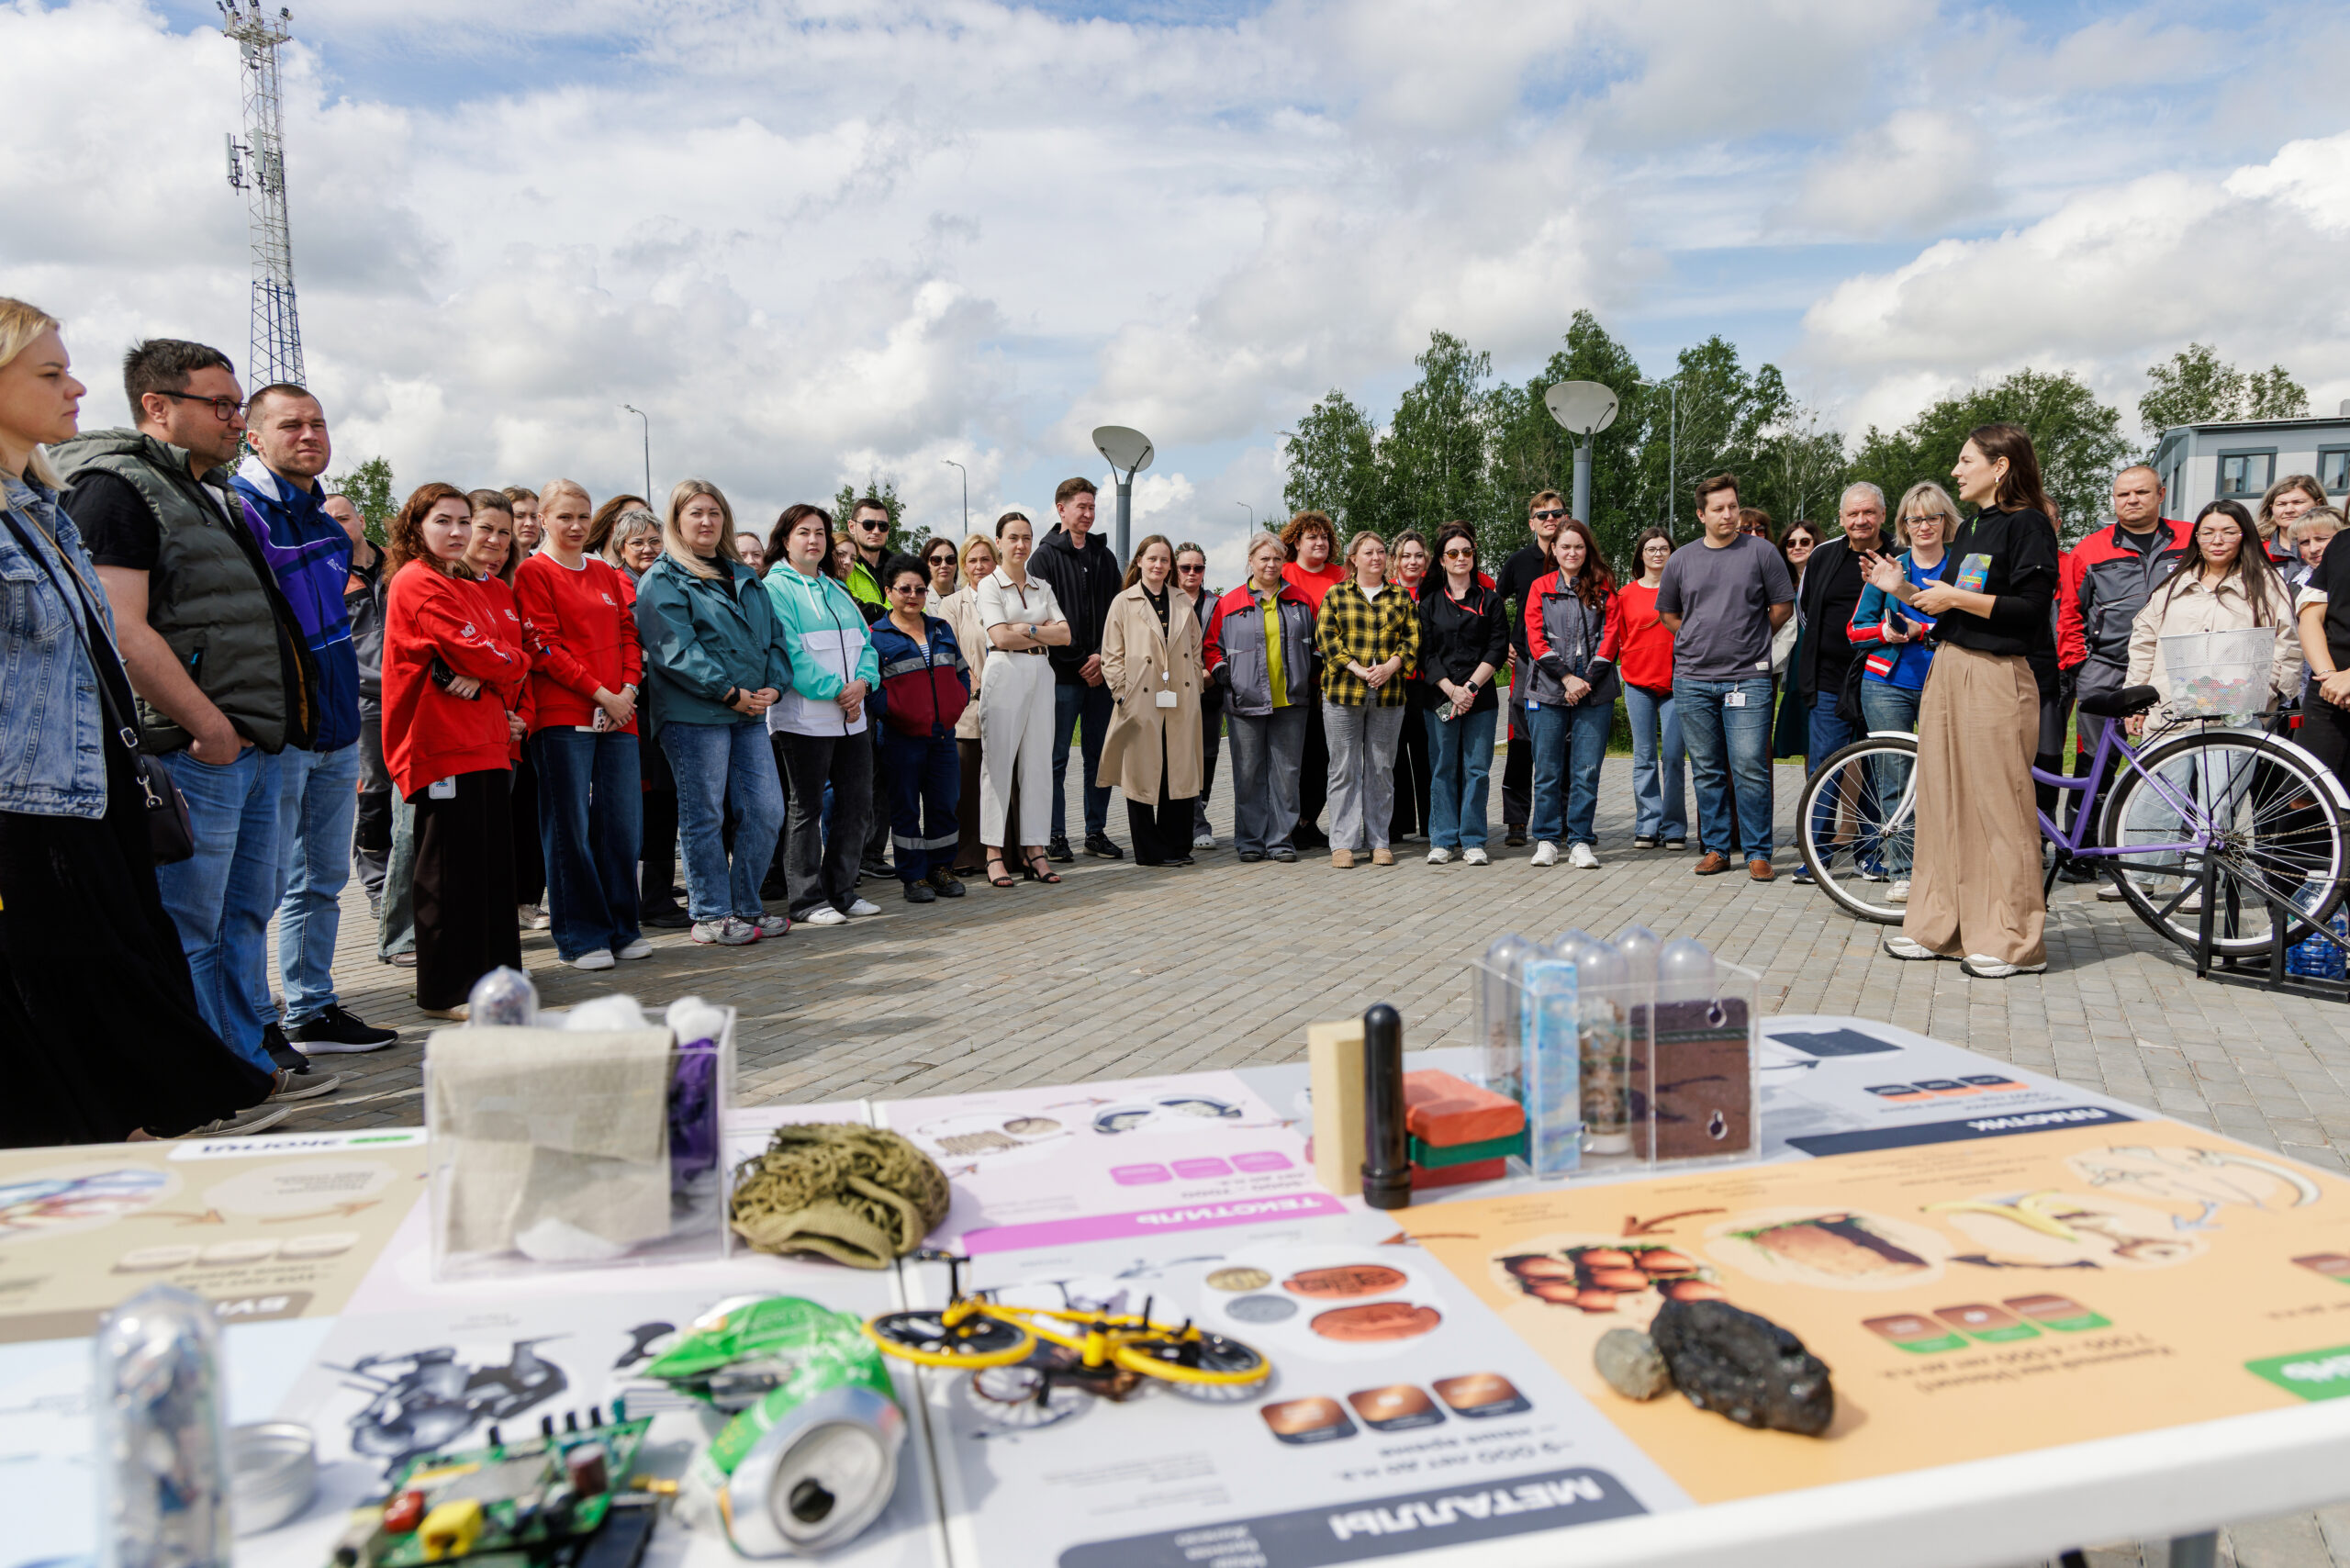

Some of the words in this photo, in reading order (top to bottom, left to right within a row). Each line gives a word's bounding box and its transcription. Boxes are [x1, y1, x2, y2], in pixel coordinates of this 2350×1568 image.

[1966, 1107, 2109, 1133] ПЛАСТИК
[1136, 1194, 1323, 1226] ТЕКСТИЛЬ
[1326, 1474, 1606, 1542] МЕТАЛЛЫ
